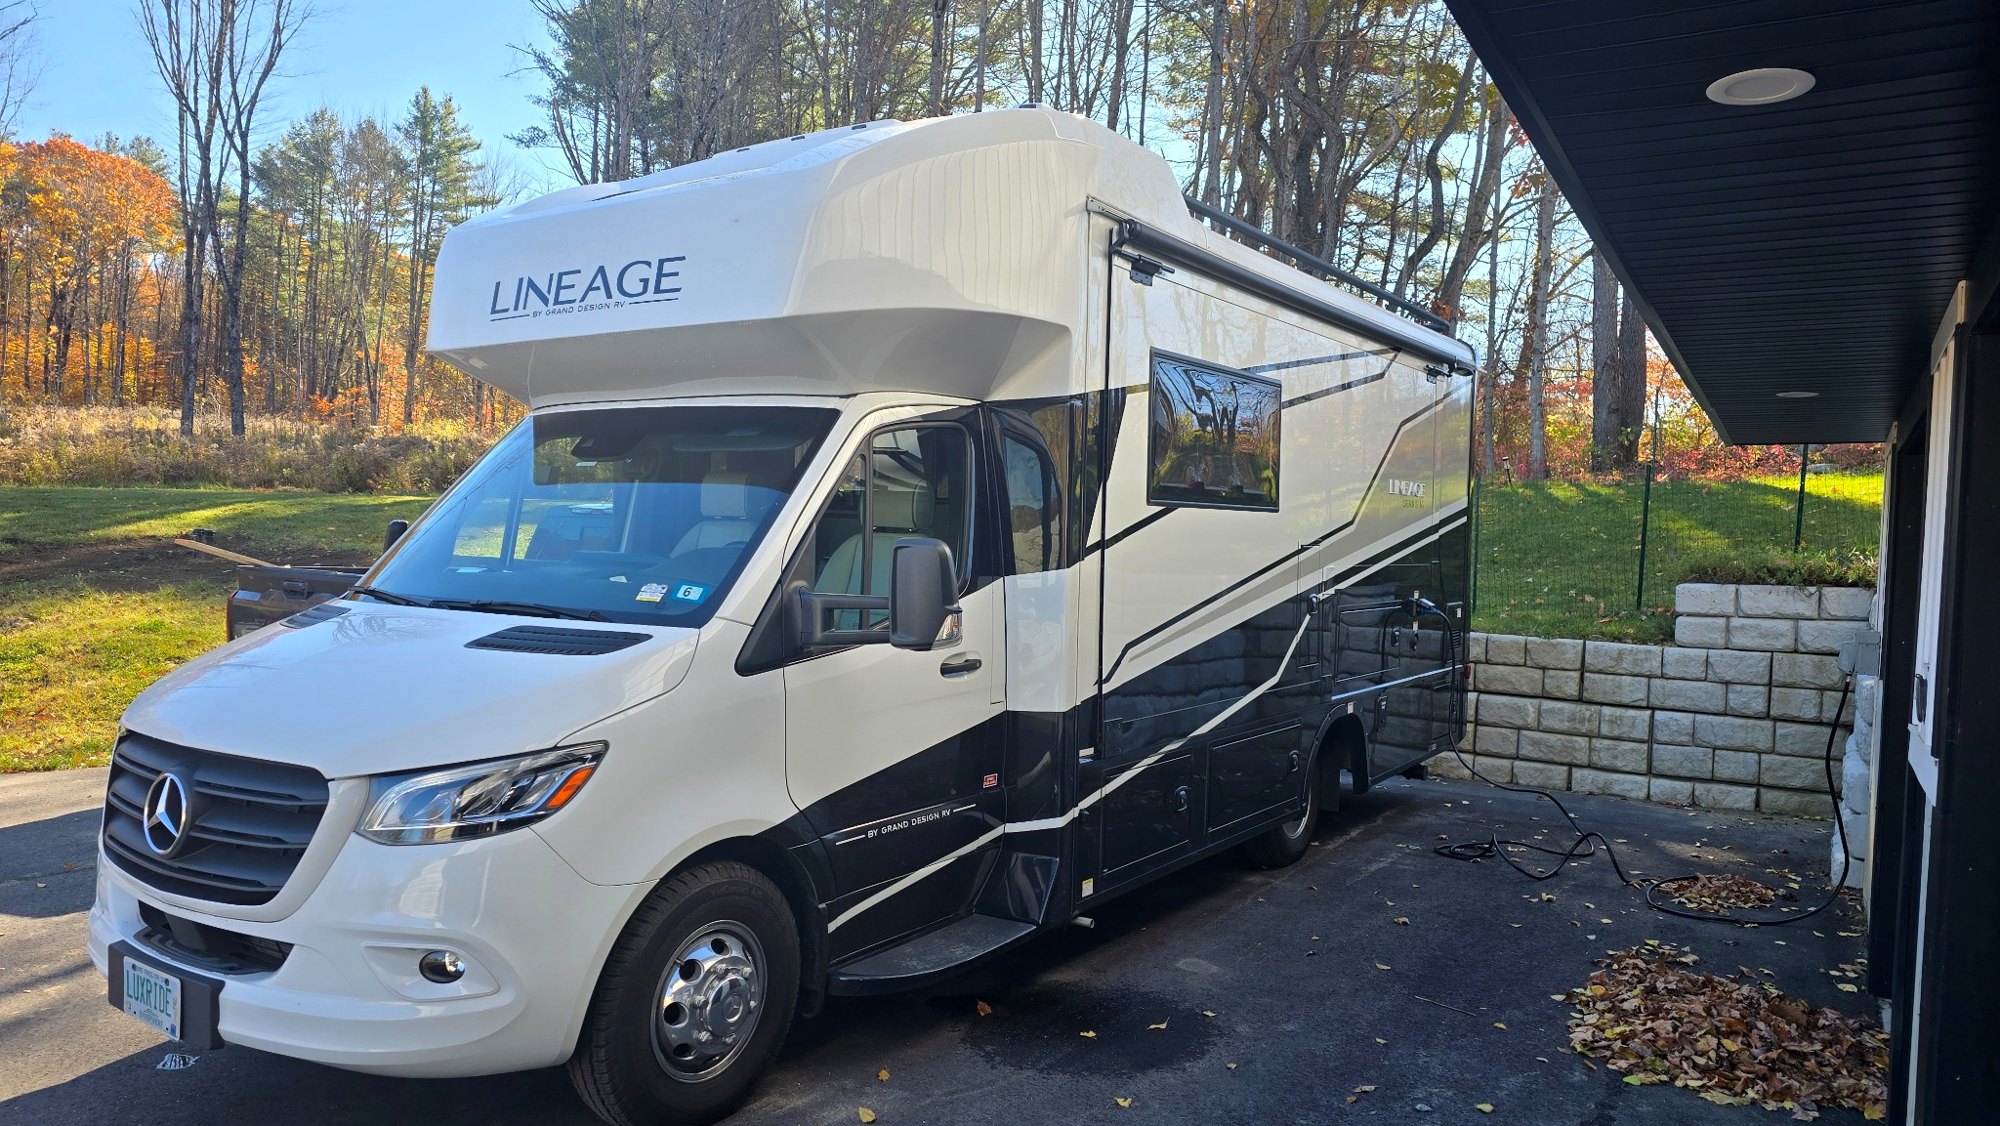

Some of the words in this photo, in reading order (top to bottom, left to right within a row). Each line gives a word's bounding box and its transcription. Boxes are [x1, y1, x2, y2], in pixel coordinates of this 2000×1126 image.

[490, 256, 686, 315] LINEAGE
[532, 310, 543, 318] BY
[545, 306, 574, 316] GRAND
[577, 302, 611, 313] DESIGN
[613, 300, 626, 309] RV
[1389, 479, 1426, 497] LINEAGE
[683, 587, 693, 598] 6
[867, 828, 878, 838] BY
[881, 820, 909, 835] GRAND
[911, 811, 940, 826] DESIGN
[941, 808, 951, 817] RV
[126, 969, 172, 1018] LUXRIDE
